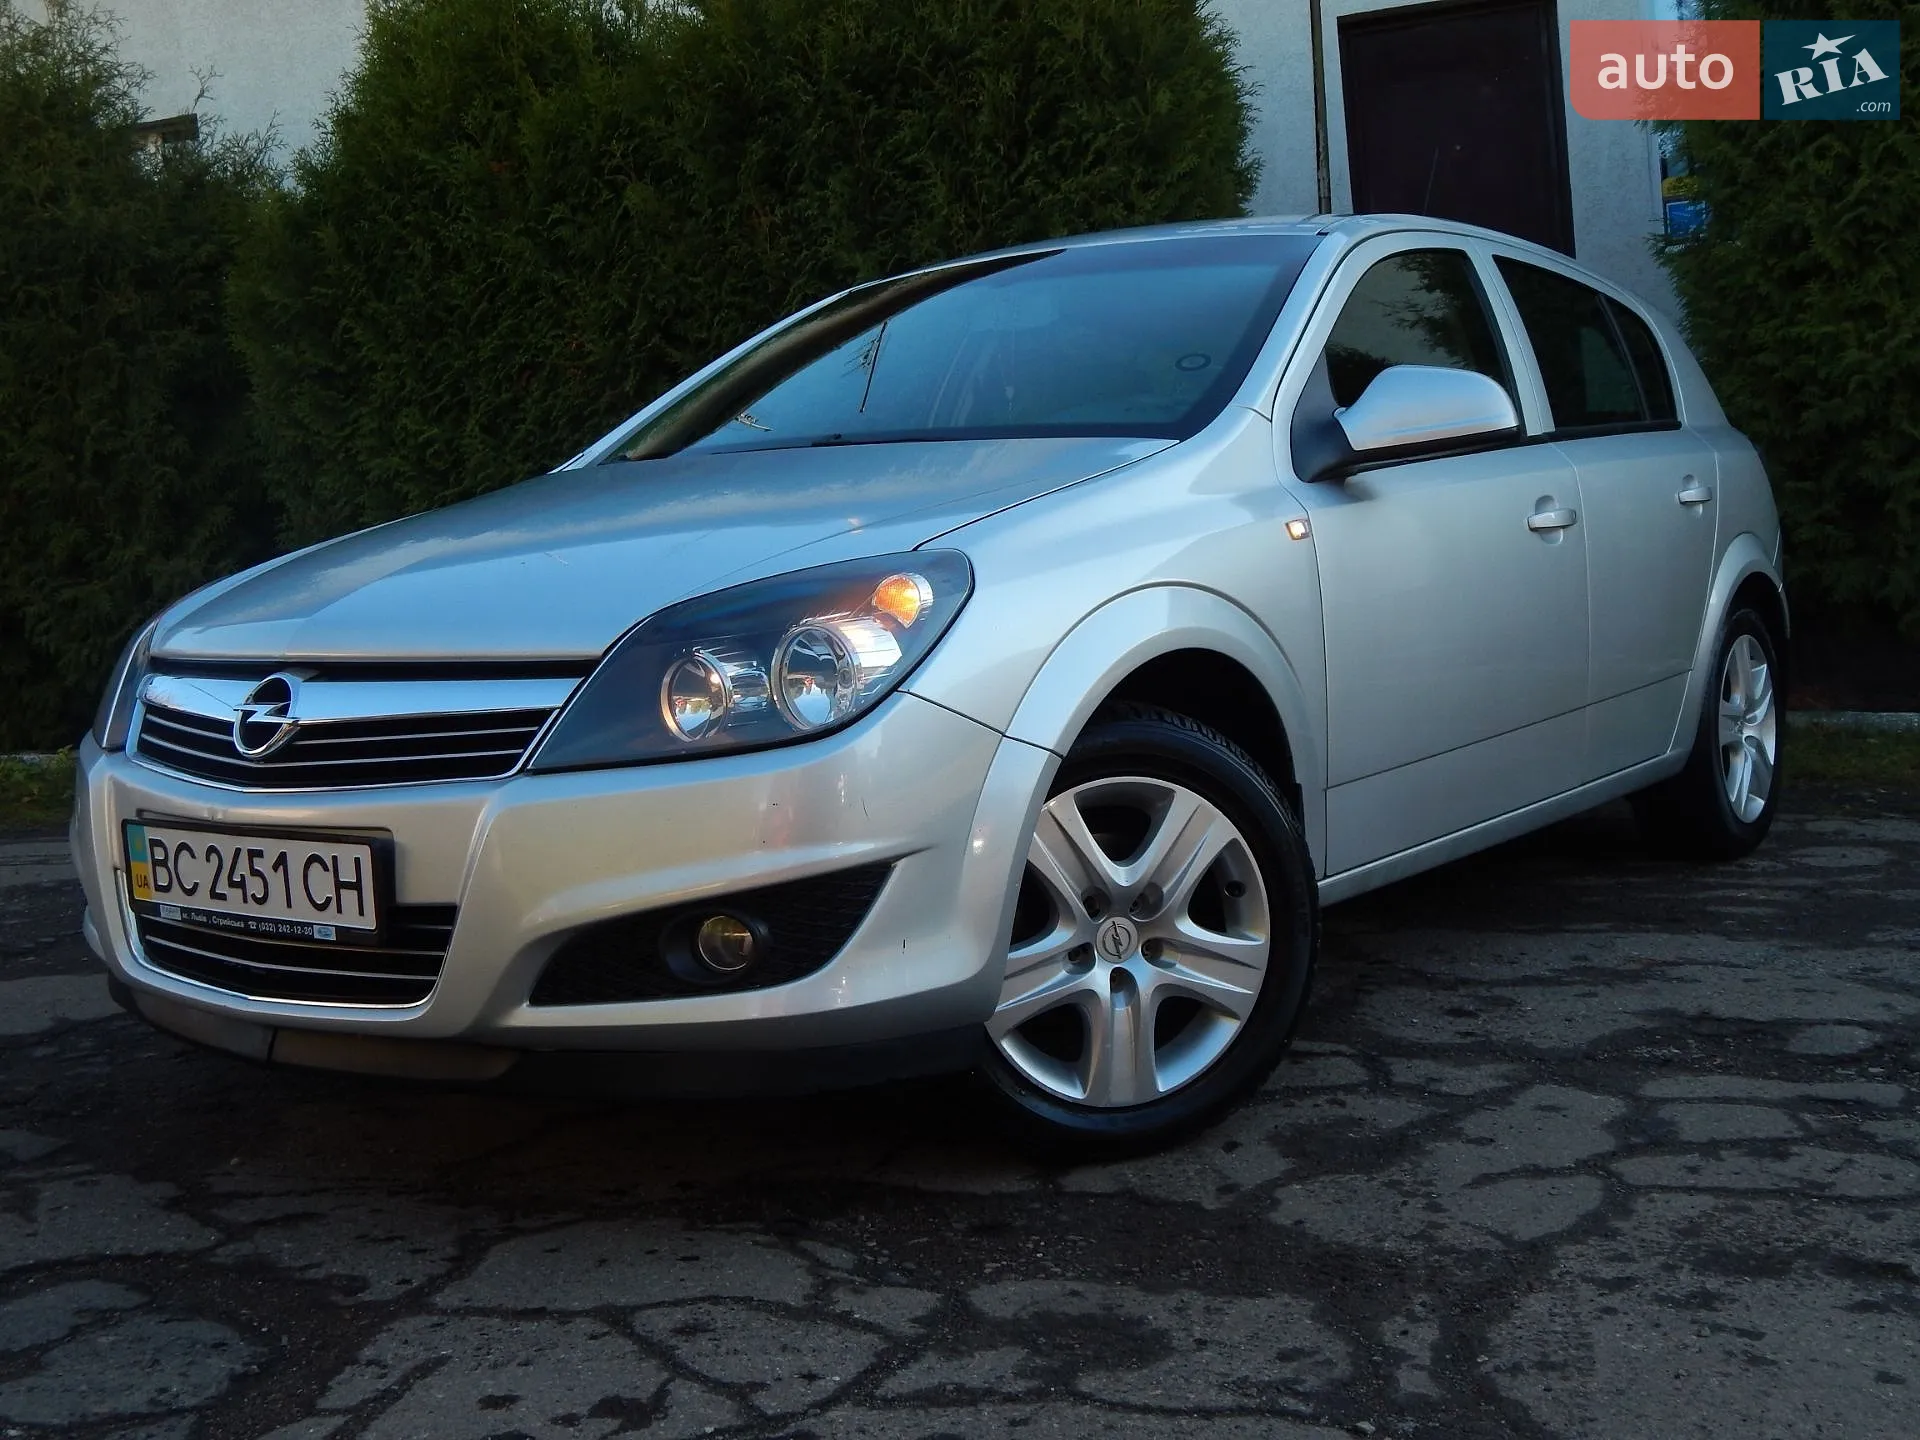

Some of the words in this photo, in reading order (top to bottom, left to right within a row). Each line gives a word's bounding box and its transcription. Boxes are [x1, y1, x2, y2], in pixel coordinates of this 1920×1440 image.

[136, 873, 150, 889] UA
[148, 837, 200, 897] BC
[205, 844, 292, 909] 2451
[303, 852, 365, 917] CH
